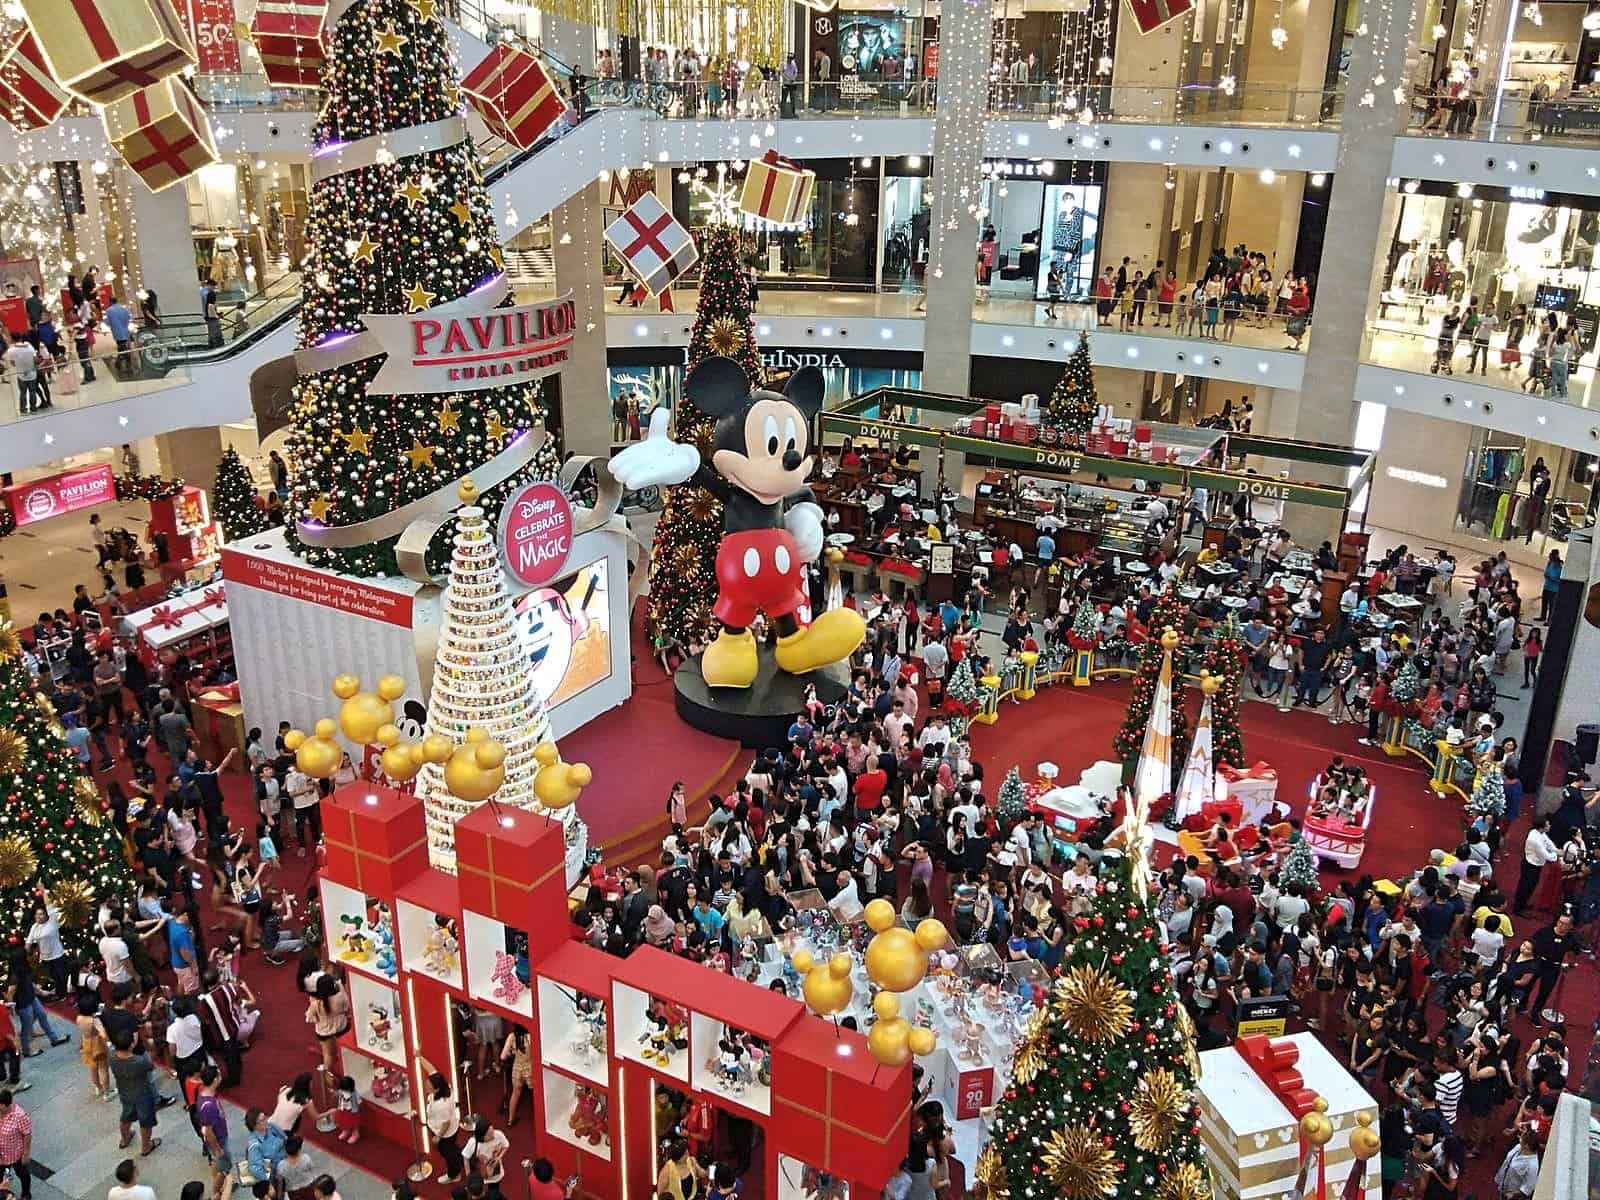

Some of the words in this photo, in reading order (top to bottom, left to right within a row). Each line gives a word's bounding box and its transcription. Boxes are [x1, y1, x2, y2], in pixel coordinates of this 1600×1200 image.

[412, 300, 577, 355] PAVILION
[448, 363, 514, 381] KUALA
[60, 479, 107, 498] PAVILION
[514, 512, 566, 540] CELEBRATE
[536, 532, 548, 541] THE
[259, 576, 278, 588] Thank
[278, 584, 289, 592] you
[290, 584, 300, 596] for
[301, 586, 317, 601] being
[318, 592, 331, 602] part
[332, 595, 338, 607] of
[340, 597, 350, 608] the
[265, 564, 294, 580] Mickey's
[296, 572, 321, 586] designed
[321, 578, 329, 592] by
[330, 584, 357, 599] everyday
[966, 1089, 984, 1104] 90
